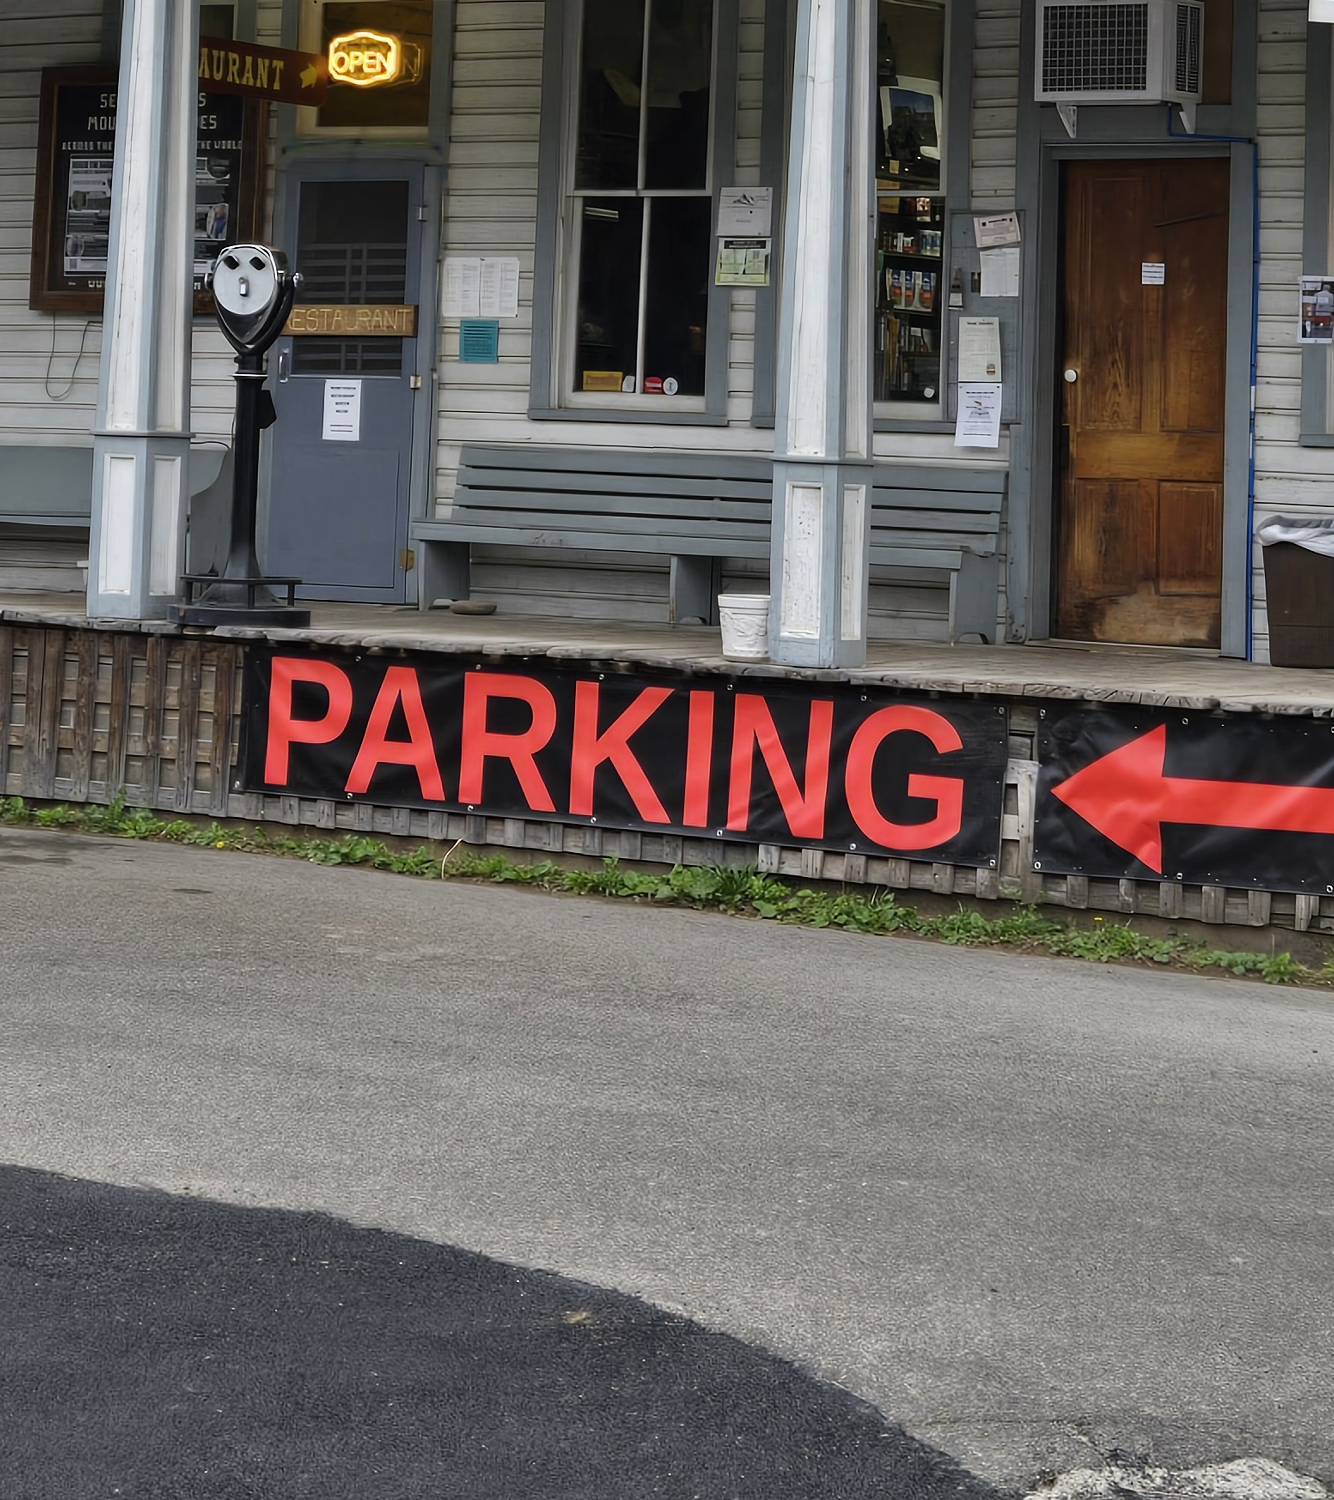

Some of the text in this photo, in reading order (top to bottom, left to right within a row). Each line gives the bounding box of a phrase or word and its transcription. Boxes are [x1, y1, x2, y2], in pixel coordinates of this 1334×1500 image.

[198, 48, 284, 91] AURANT
[333, 51, 393, 74] OPEN
[263, 655, 965, 851] PARKING
